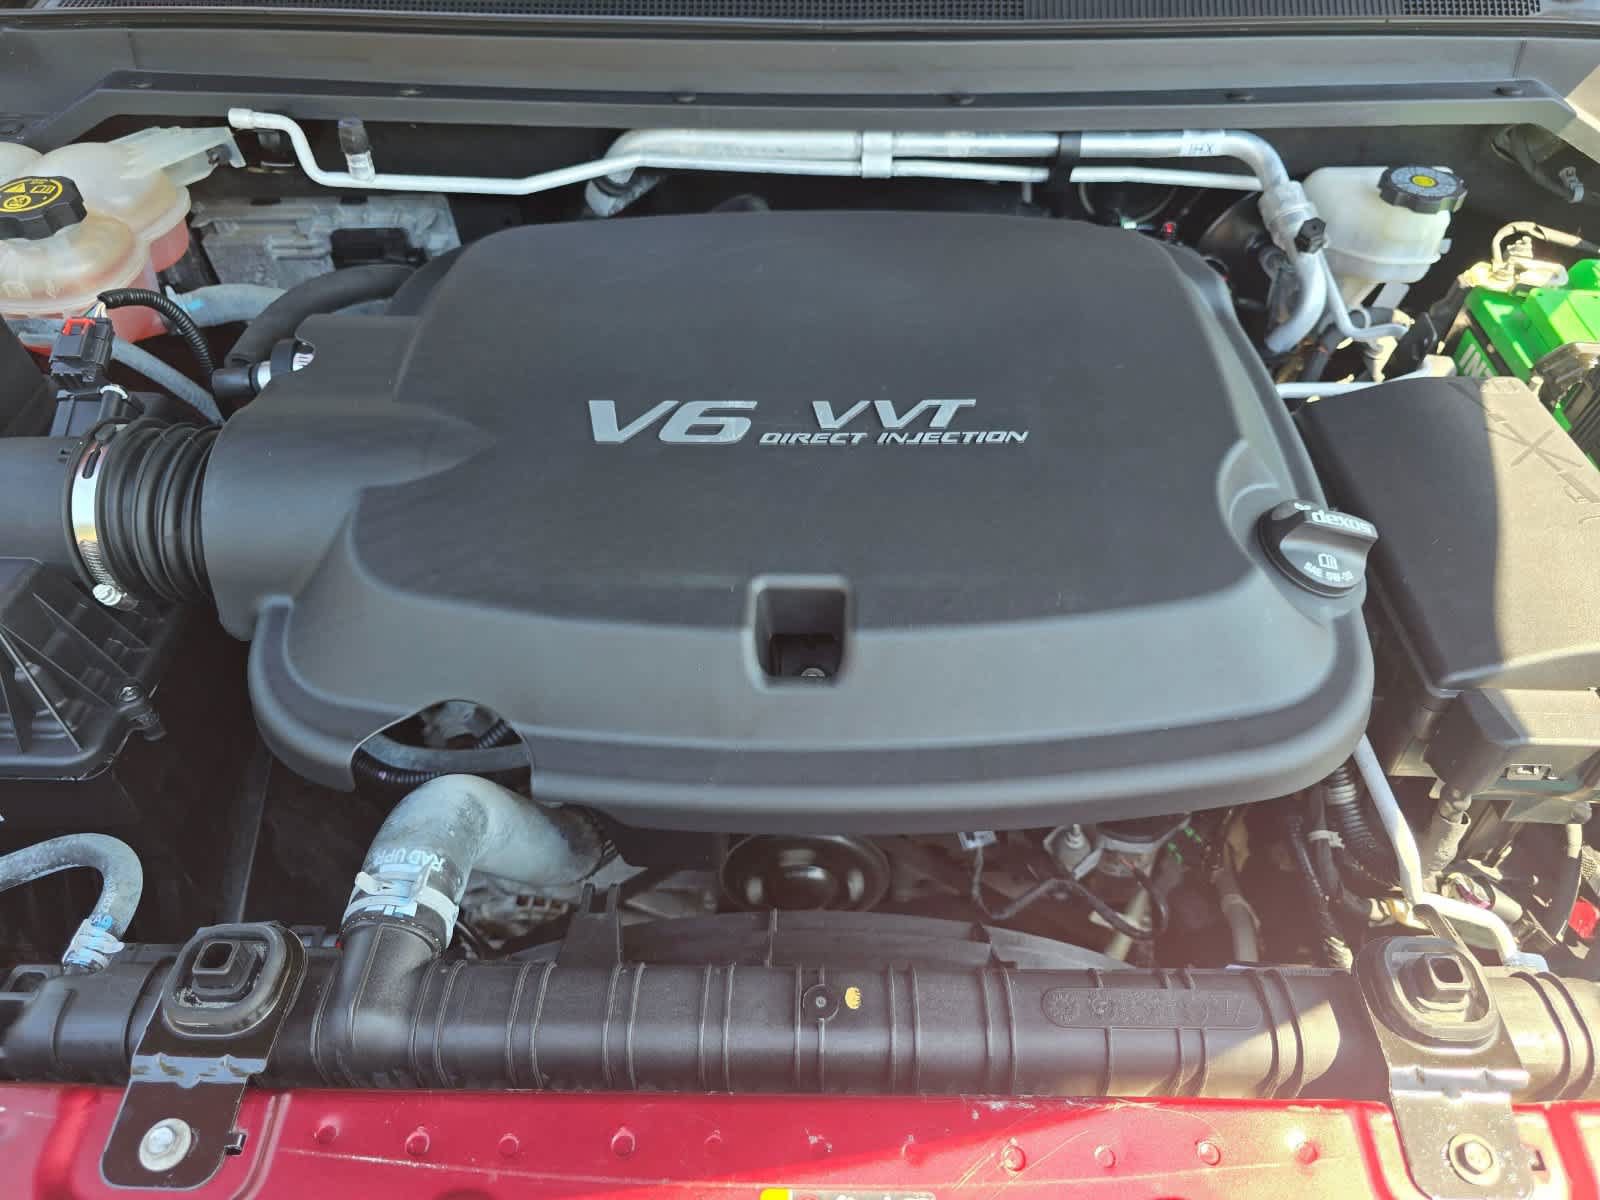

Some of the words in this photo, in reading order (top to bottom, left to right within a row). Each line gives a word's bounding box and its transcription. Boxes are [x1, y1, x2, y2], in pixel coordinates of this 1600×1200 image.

[588, 400, 758, 443] V6
[812, 399, 976, 429] VVT
[759, 432, 868, 445] DIRECT
[877, 431, 1029, 445] INJECTION
